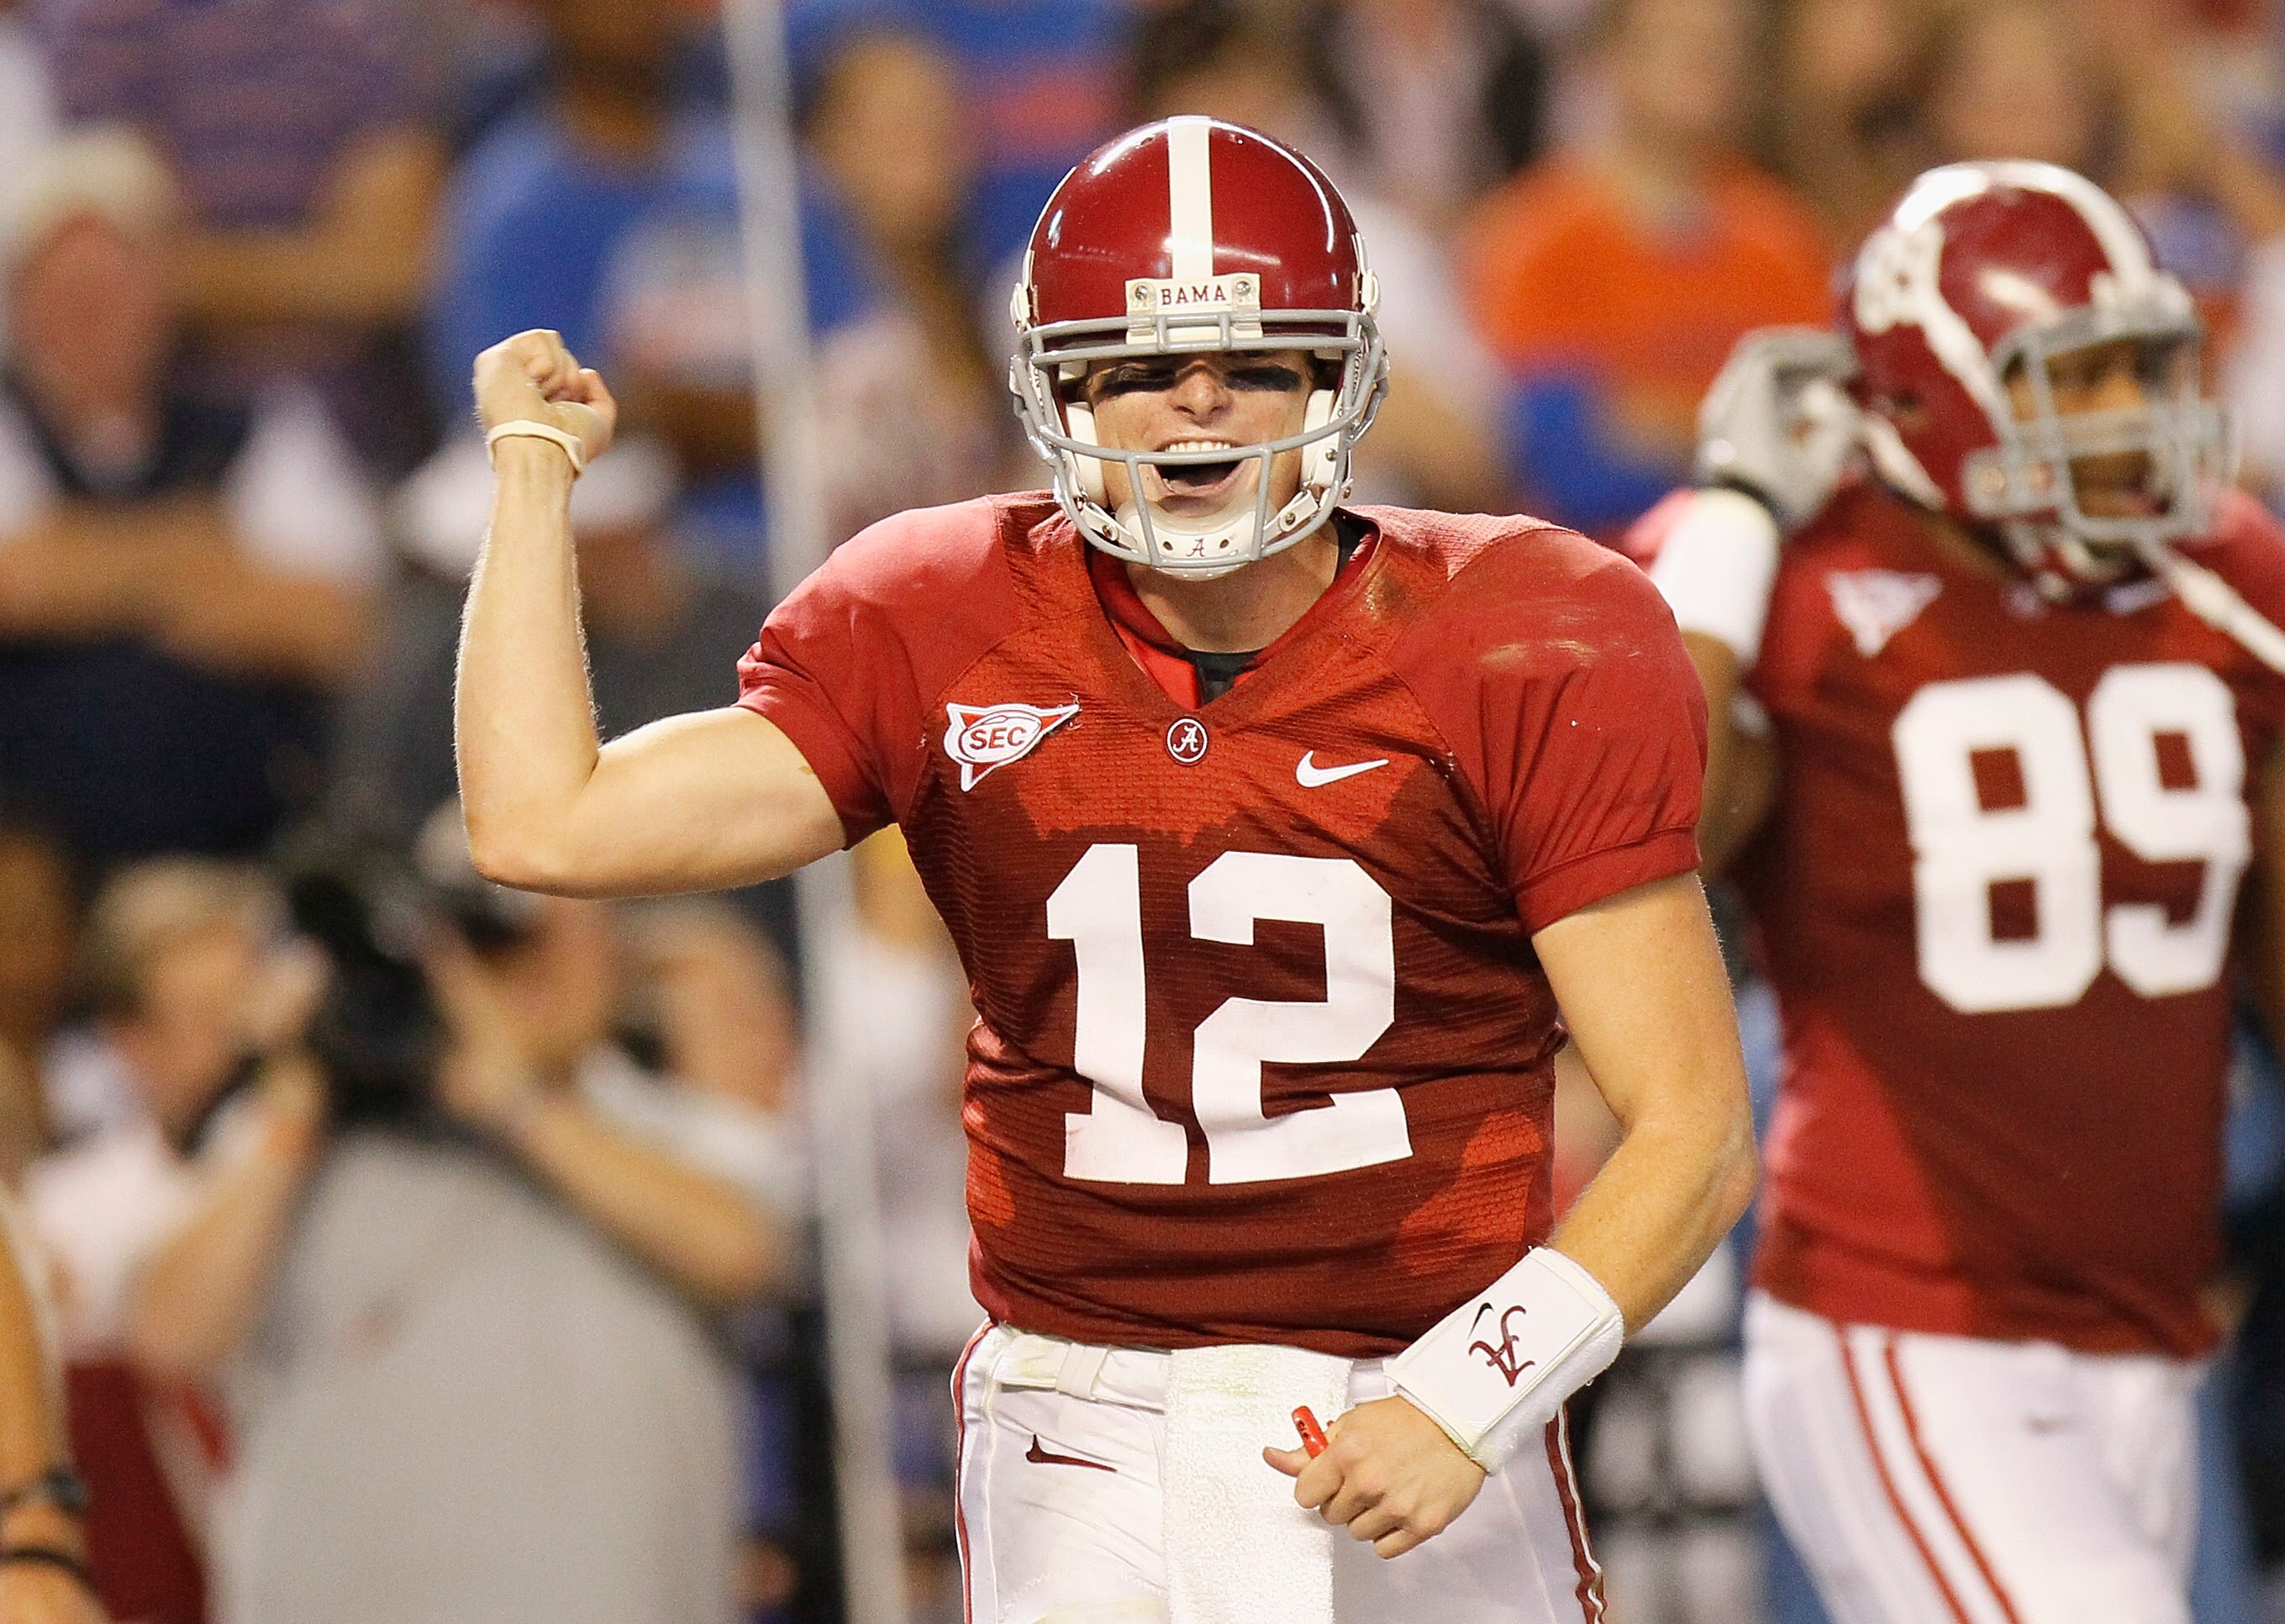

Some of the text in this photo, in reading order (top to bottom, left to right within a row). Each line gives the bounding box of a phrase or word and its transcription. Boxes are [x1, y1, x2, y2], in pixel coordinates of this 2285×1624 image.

[1161, 285, 1227, 306] BAMA
[970, 726, 1027, 750] SEC
[1892, 661, 2252, 1015] 89
[1045, 844, 1414, 1185] 12
